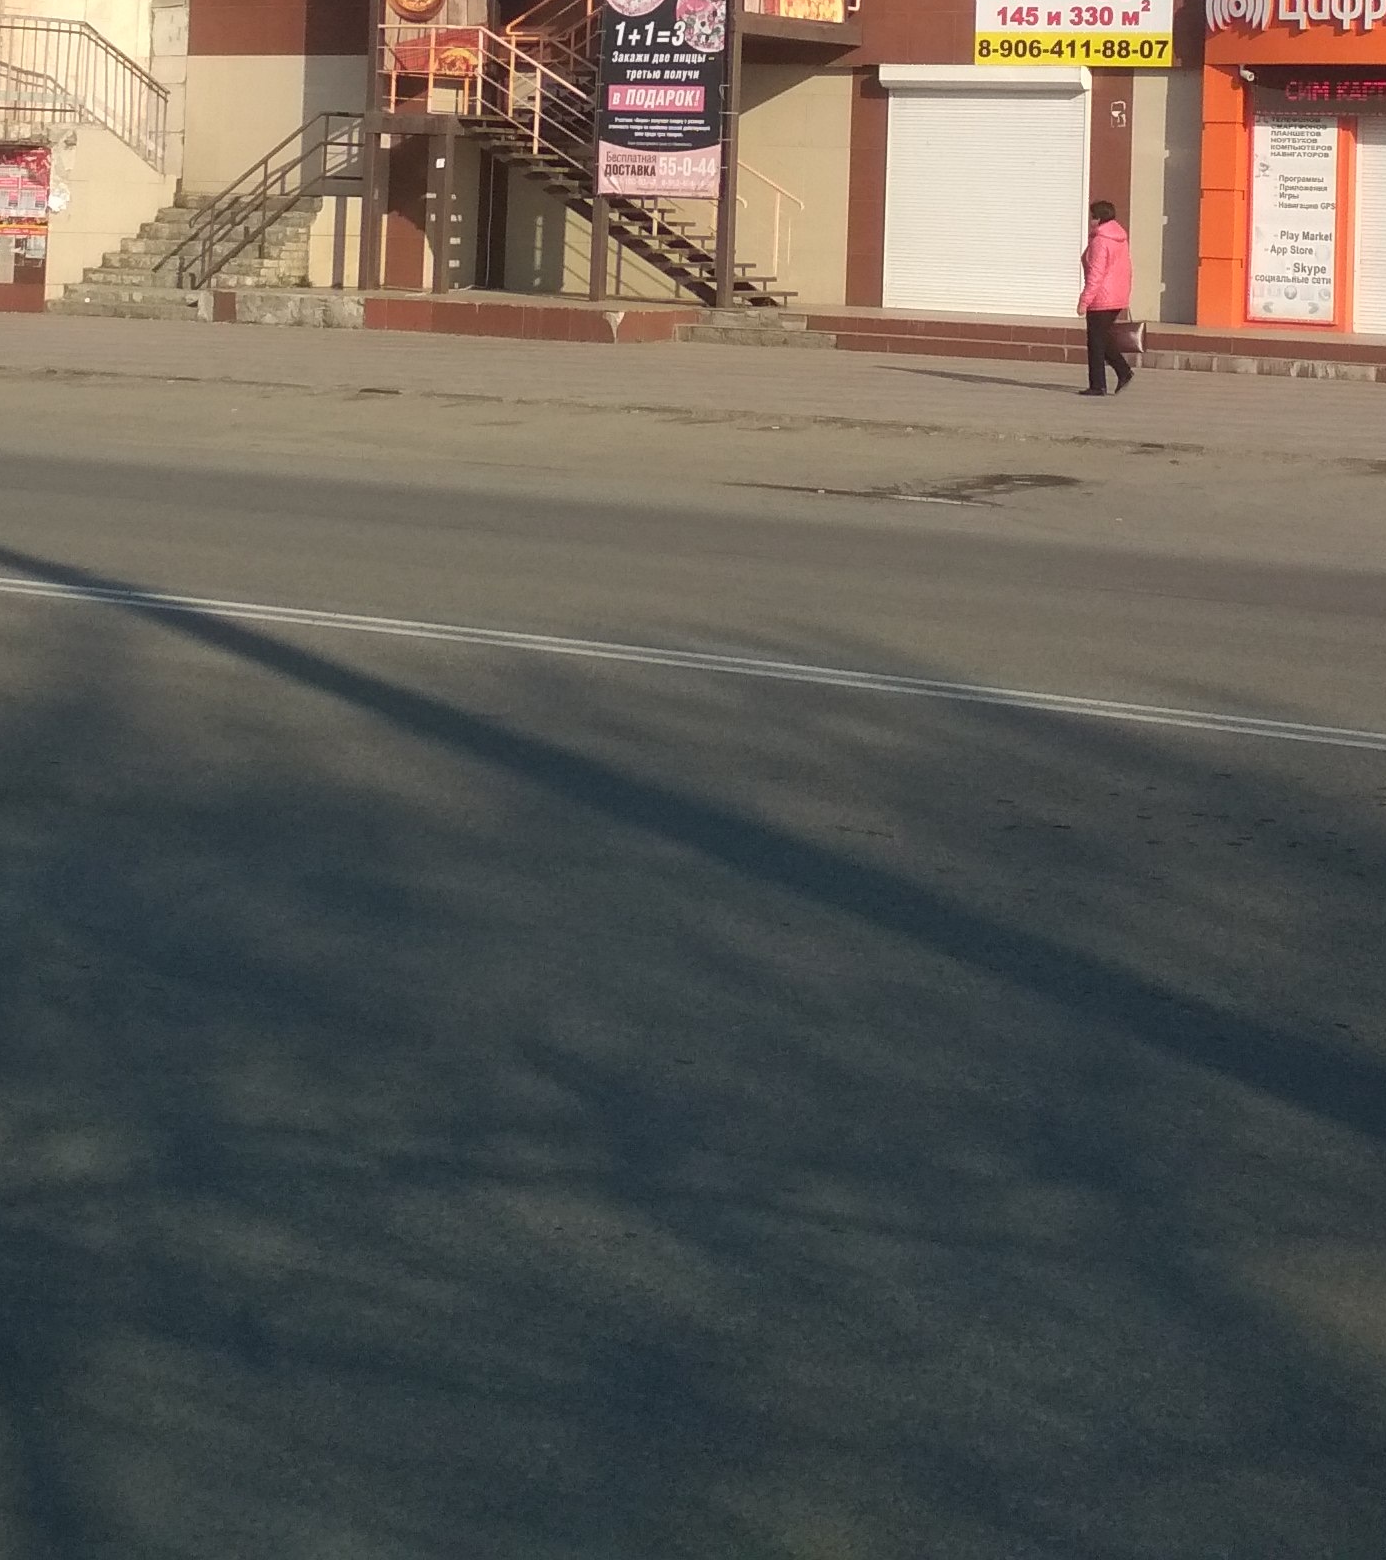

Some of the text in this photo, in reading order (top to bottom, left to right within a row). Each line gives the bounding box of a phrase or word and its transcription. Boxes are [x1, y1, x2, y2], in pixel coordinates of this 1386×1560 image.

[997, 7, 1039, 26] 145
[1047, 11, 1062, 26] и
[1069, 7, 1113, 26] 330
[614, 21, 686, 46] 1+1=3
[978, 39, 1169, 59] 8-906-411-88-07
[612, 51, 706, 65] Закажи две пиццы
[626, 70, 700, 81] третью получи
[612, 89, 701, 108] в ПОДАРОК!
[606, 151, 657, 163] Бесплатная
[604, 164, 656, 177] ДОСТАВКА
[659, 157, 716, 176] 55-0-44
[1278, 175, 1324, 183] Программы
[1279, 184, 1328, 192] Приложения
[1279, 192, 1300, 200] Игры
[1280, 230, 1332, 242] Play Market
[1270, 244, 1313, 256] App Store
[1293, 262, 1327, 276] Skype
[1255, 275, 1309, 283] социальные
